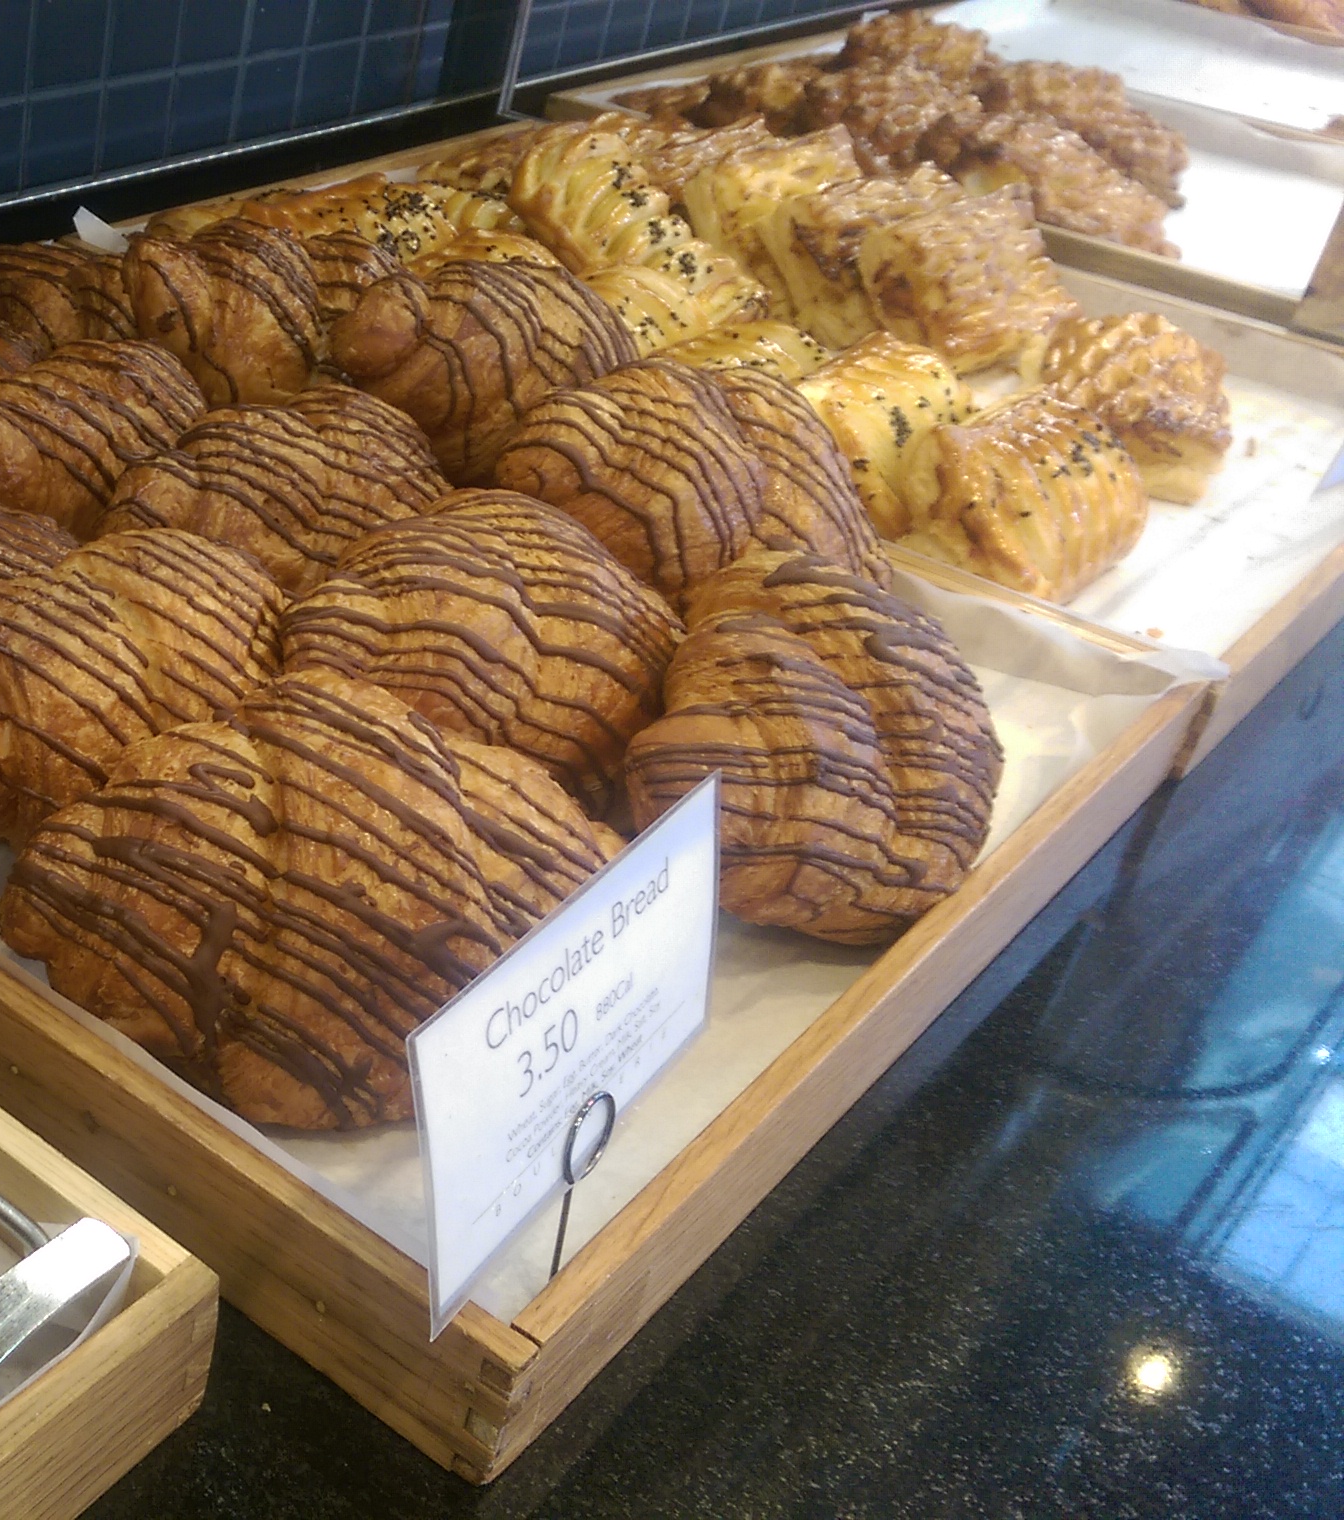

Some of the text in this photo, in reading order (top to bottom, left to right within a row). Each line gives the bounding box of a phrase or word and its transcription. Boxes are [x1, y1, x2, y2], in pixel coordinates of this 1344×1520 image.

[485, 857, 670, 1049] Chocolate Bread
[517, 971, 634, 1098] 3.50 880Cal
